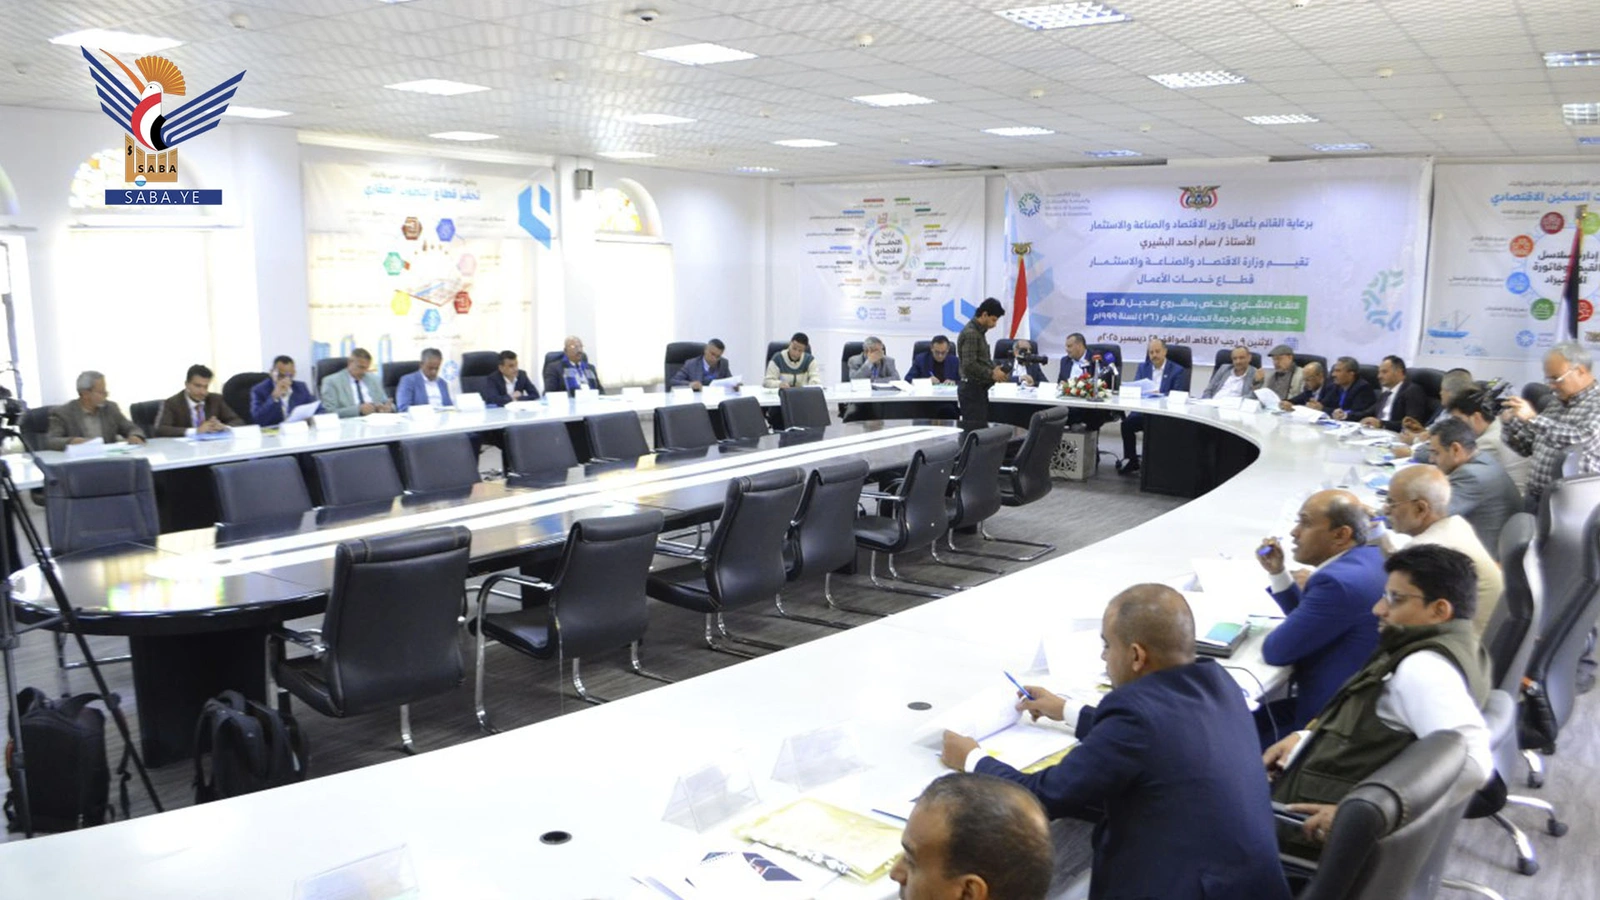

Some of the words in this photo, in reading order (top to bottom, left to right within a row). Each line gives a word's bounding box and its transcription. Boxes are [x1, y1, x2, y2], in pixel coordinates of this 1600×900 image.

[1491, 191, 1545, 206] الاقتصادي
[1547, 191, 1590, 204] التمكين
[1089, 219, 1132, 231] والاستثمار
[1134, 219, 1170, 231] والصناعة
[1172, 218, 1207, 229] الاقتصاد
[1208, 219, 1226, 231] وزير
[1228, 216, 1256, 230] بأعمال
[1258, 218, 1284, 230] القائم
[1286, 219, 1313, 231] برعاية
[875, 239, 902, 247] التحفيز
[1140, 236, 1174, 249] البشيري
[1176, 235, 1197, 246] أحمد
[1198, 237, 1216, 248] سام
[1218, 237, 1223, 247] /
[1225, 235, 1255, 246] الأستاذ
[875, 247, 902, 257] الاقتصادي
[1579, 251, 1599, 262] إدار
[1089, 256, 1143, 268] والاستثمار
[1145, 256, 1194, 268] والصناعة
[1197, 256, 1240, 267] الاقتصاد
[1242, 257, 1264, 269] وزارة
[1266, 257, 1310, 269] تقيم
[1579, 262, 1600, 275] القيم
[1137, 272, 1170, 285] الأعمال
[1172, 274, 1214, 284] خدمات
[1216, 273, 1254, 286] قطاع
[1092, 298, 1125, 307] قانون
[1126, 298, 1159, 308] تعديل
[1160, 298, 1198, 309] بمشروع
[1199, 300, 1229, 309] الخاص
[1230, 300, 1273, 312] التشاوري
[1274, 301, 1300, 310] اللقاء
[1093, 312, 1117, 322] ١٩٩٩م
[1119, 312, 1138, 320] لسنة
[1160, 312, 1176, 323] رقم
[1177, 313, 1212, 322] الحسابات
[1213, 314, 1247, 325] ومراجعة
[1248, 315, 1274, 326] تدقيق
[1275, 315, 1299, 325] مهنة
[1097, 333, 1118, 343] ٢٠٢٥م
[1120, 335, 1146, 344] ديسمبر
[1221, 337, 1238, 346] رجب
